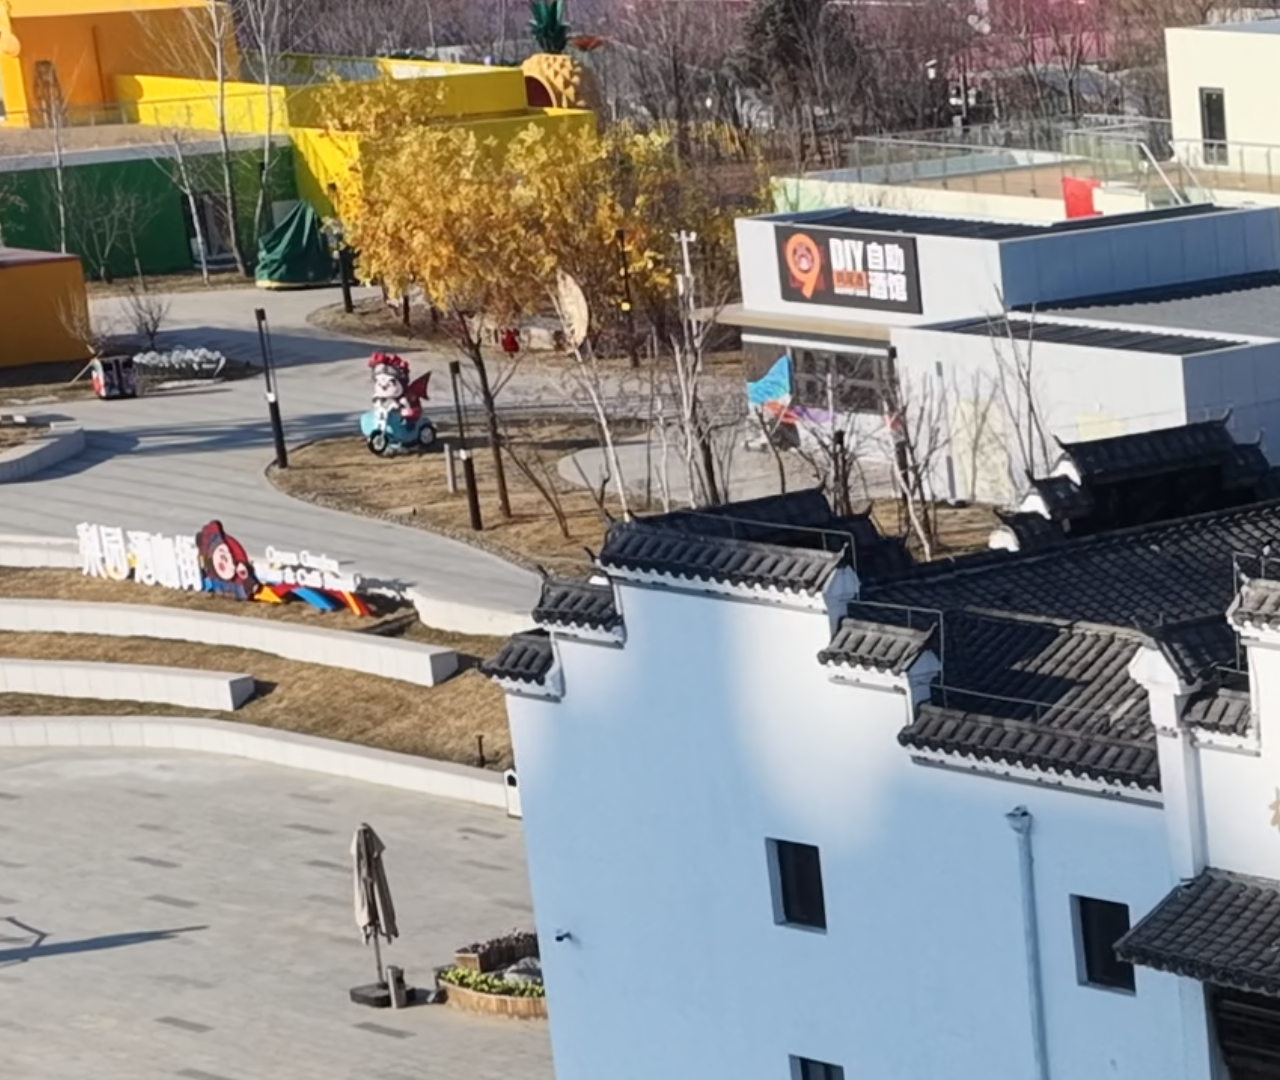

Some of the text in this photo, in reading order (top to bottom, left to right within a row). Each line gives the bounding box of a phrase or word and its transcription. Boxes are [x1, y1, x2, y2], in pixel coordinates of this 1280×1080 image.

[829, 238, 905, 273] DIY 自助
[868, 271, 908, 302] 酒馆
